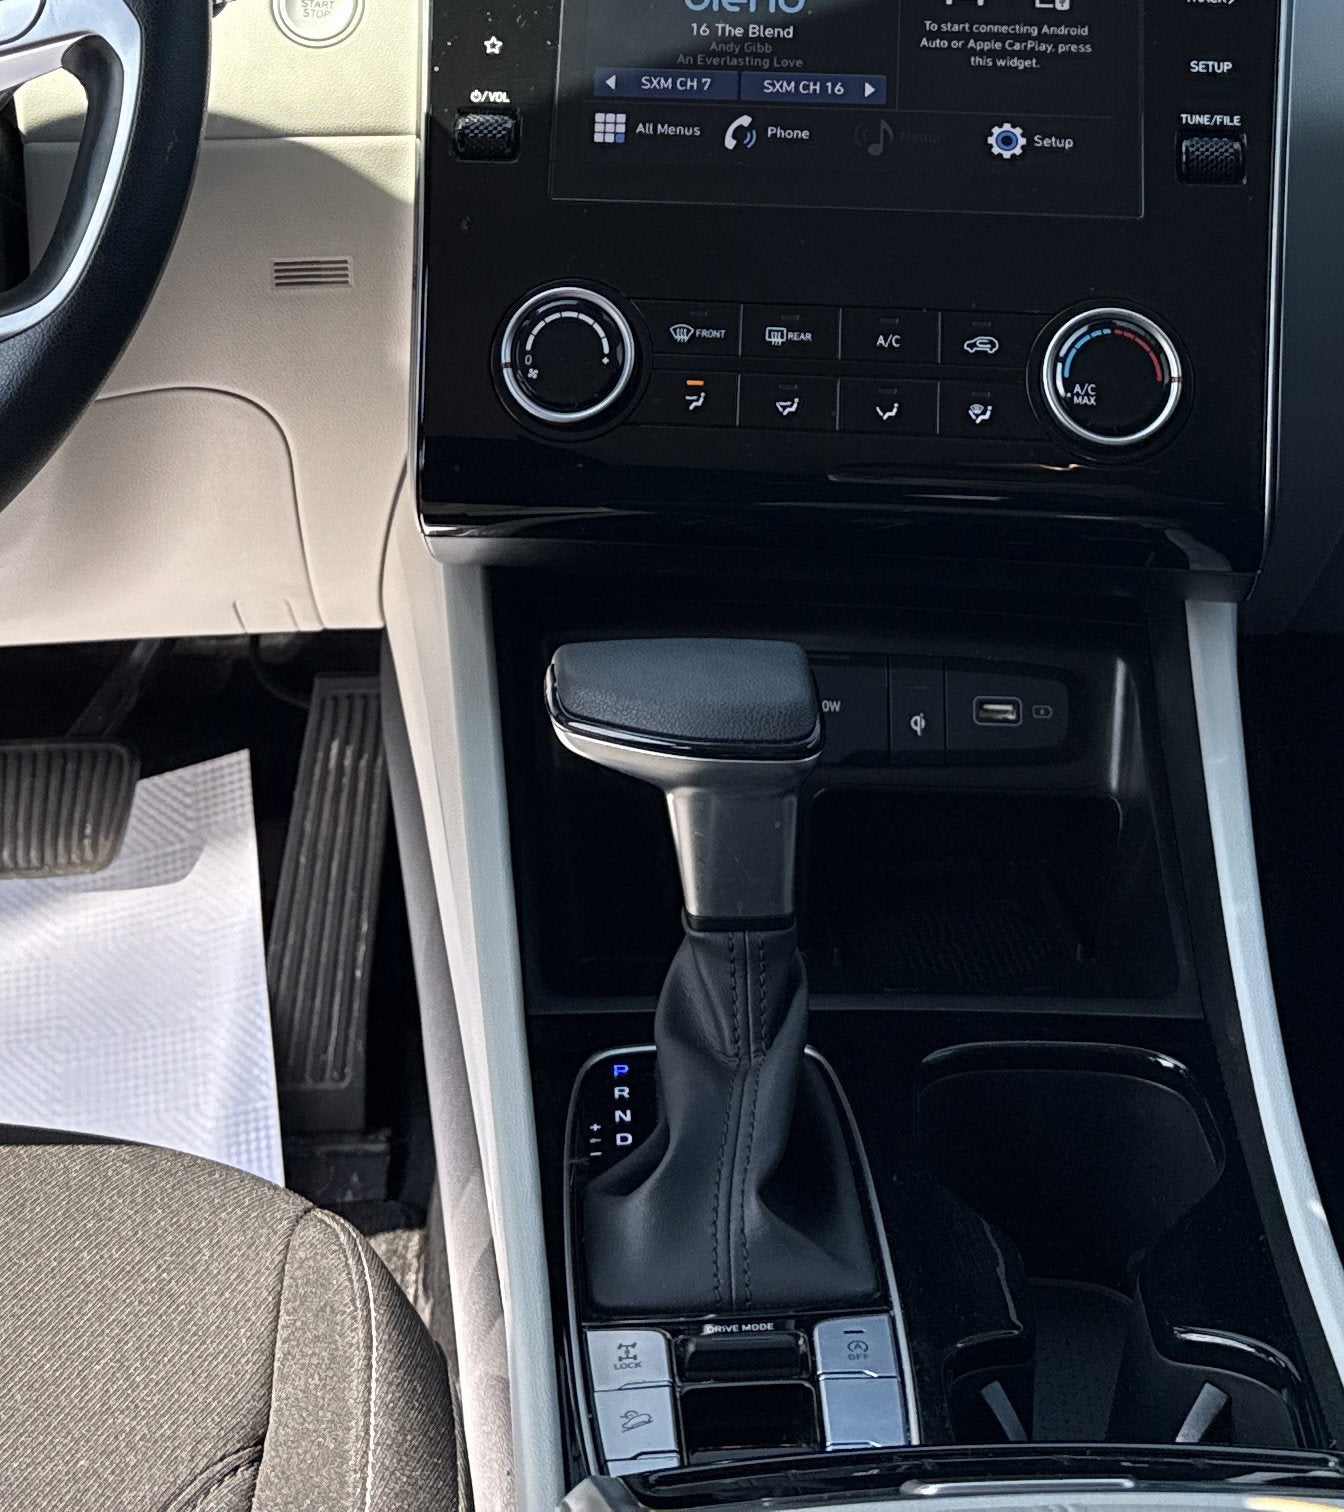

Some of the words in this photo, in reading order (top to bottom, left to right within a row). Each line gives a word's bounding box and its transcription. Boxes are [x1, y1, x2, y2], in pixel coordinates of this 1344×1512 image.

[302, 8, 332, 19] STOP
[690, 22, 711, 37] 16
[714, 23, 744, 38] The
[748, 24, 794, 39] Blend
[923, 20, 938, 32] To
[940, 22, 971, 33] start
[972, 23, 1039, 37] connecting
[1041, 24, 1089, 36] Android
[709, 41, 741, 55] Andy
[744, 41, 773, 54] Gibb
[919, 37, 949, 49] Auto
[950, 40, 965, 50] or
[967, 39, 1003, 53] Apple
[1005, 39, 1056, 54] CarPlay,
[1058, 43, 1093, 55] press
[676, 54, 694, 66] An
[697, 54, 771, 70] Everlasting
[773, 56, 804, 69] Love
[970, 55, 993, 67] this
[995, 56, 1041, 70] widget.
[1189, 60, 1233, 74] SETUP
[640, 76, 674, 91] SXM
[676, 76, 698, 91] CH
[701, 77, 712, 91] 7
[763, 79, 796, 94] SXM
[798, 81, 821, 95] CH
[825, 81, 844, 95] 16
[1180, 113, 1242, 127] TUNE/FILE
[635, 121, 654, 136] All
[656, 122, 701, 137] Menus
[767, 126, 810, 140] Phone
[1033, 134, 1074, 150] Setup
[695, 328, 726, 340] FRONT
[787, 331, 813, 342] REAR
[875, 334, 901, 349] A/C
[1073, 383, 1097, 396] A/C
[1073, 395, 1097, 406] MAX
[613, 1064, 630, 1078] P
[613, 1086, 631, 1100] R
[614, 1109, 632, 1123] N
[615, 1132, 633, 1146] D
[706, 1323, 739, 1334] DRIVE
[741, 1322, 775, 1333] MODE
[847, 1352, 870, 1362] OFF
[613, 1361, 642, 1371] LOCK
